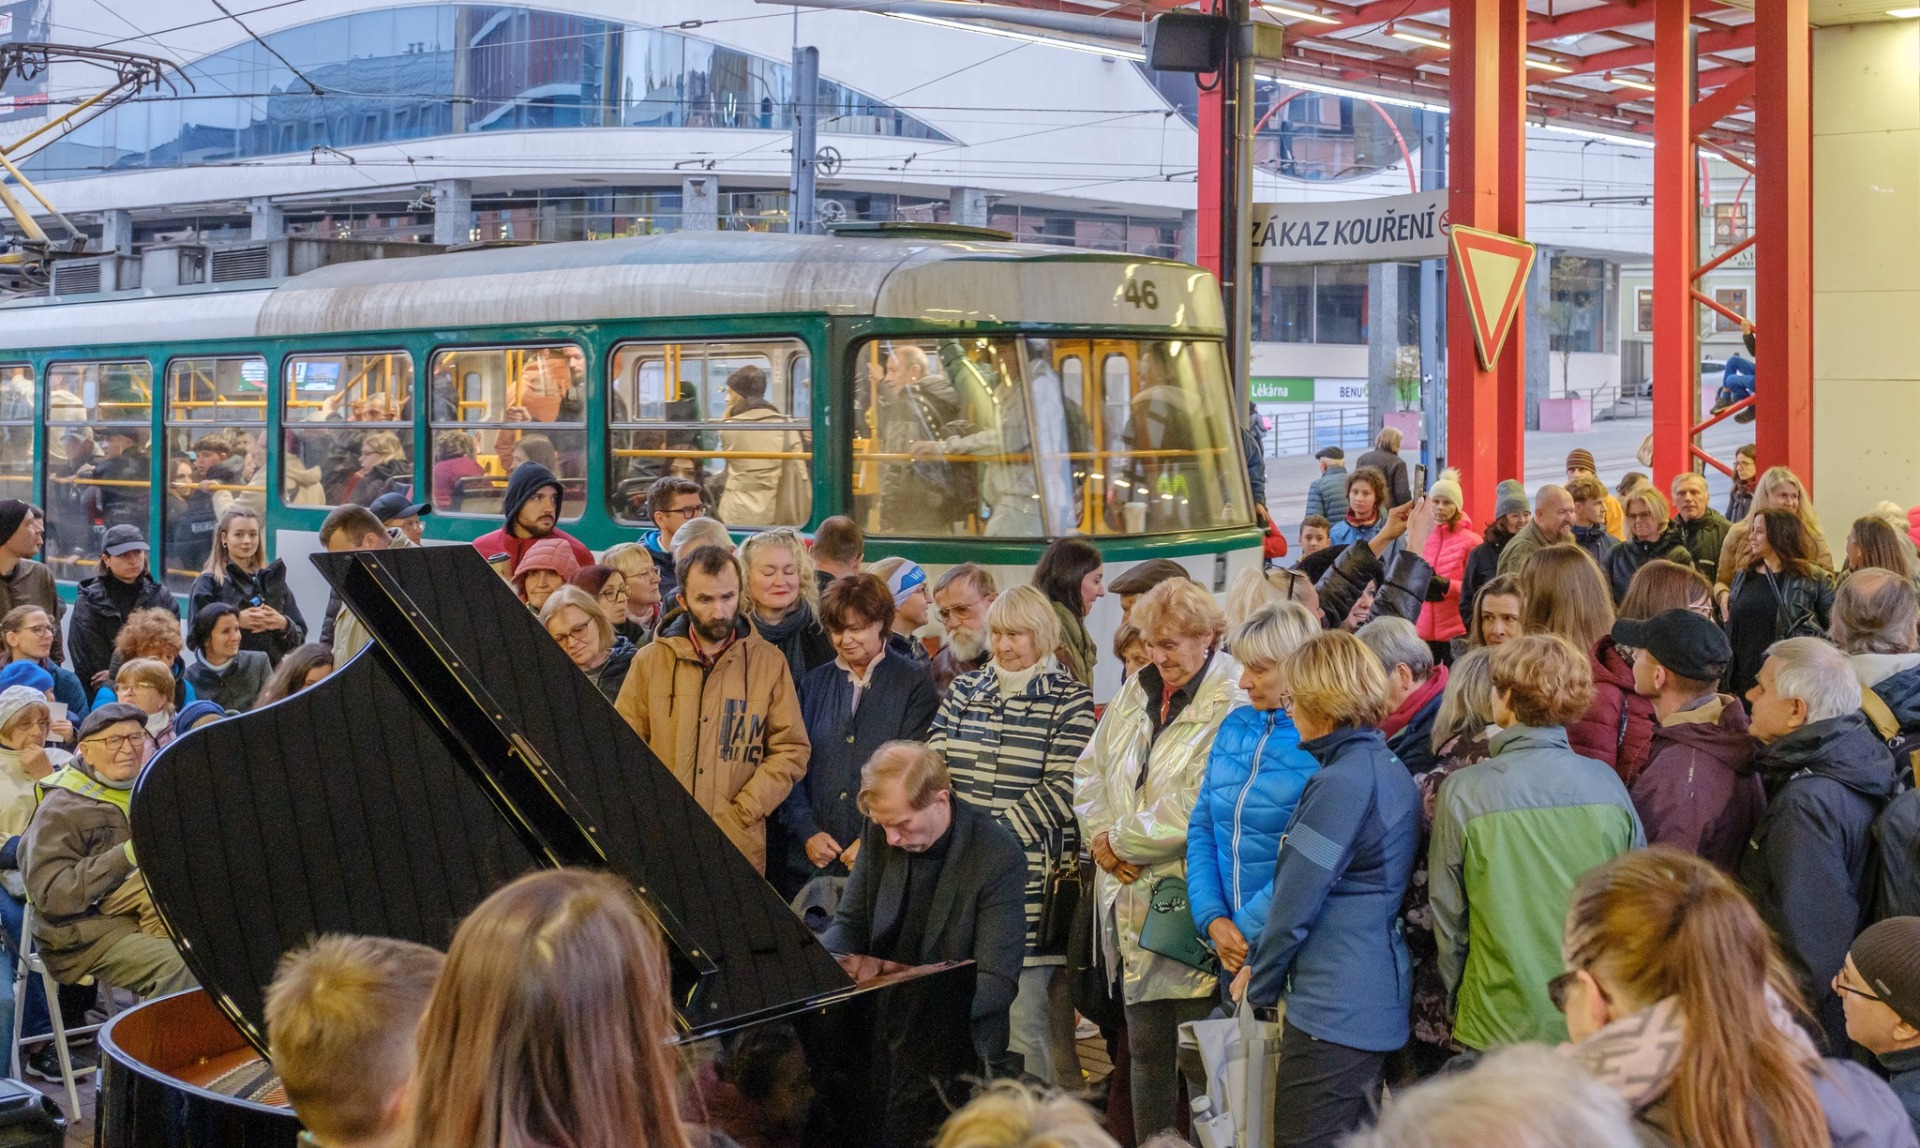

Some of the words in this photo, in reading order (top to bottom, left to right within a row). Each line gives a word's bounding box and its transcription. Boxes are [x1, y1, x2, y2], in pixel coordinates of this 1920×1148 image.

[1251, 214, 1330, 247] ZÁKAZ
[1333, 203, 1436, 246] KOUŘENÍ
[1125, 279, 1158, 310] 46
[1251, 383, 1289, 398] Lékárna
[1340, 386, 1363, 398] BENU
